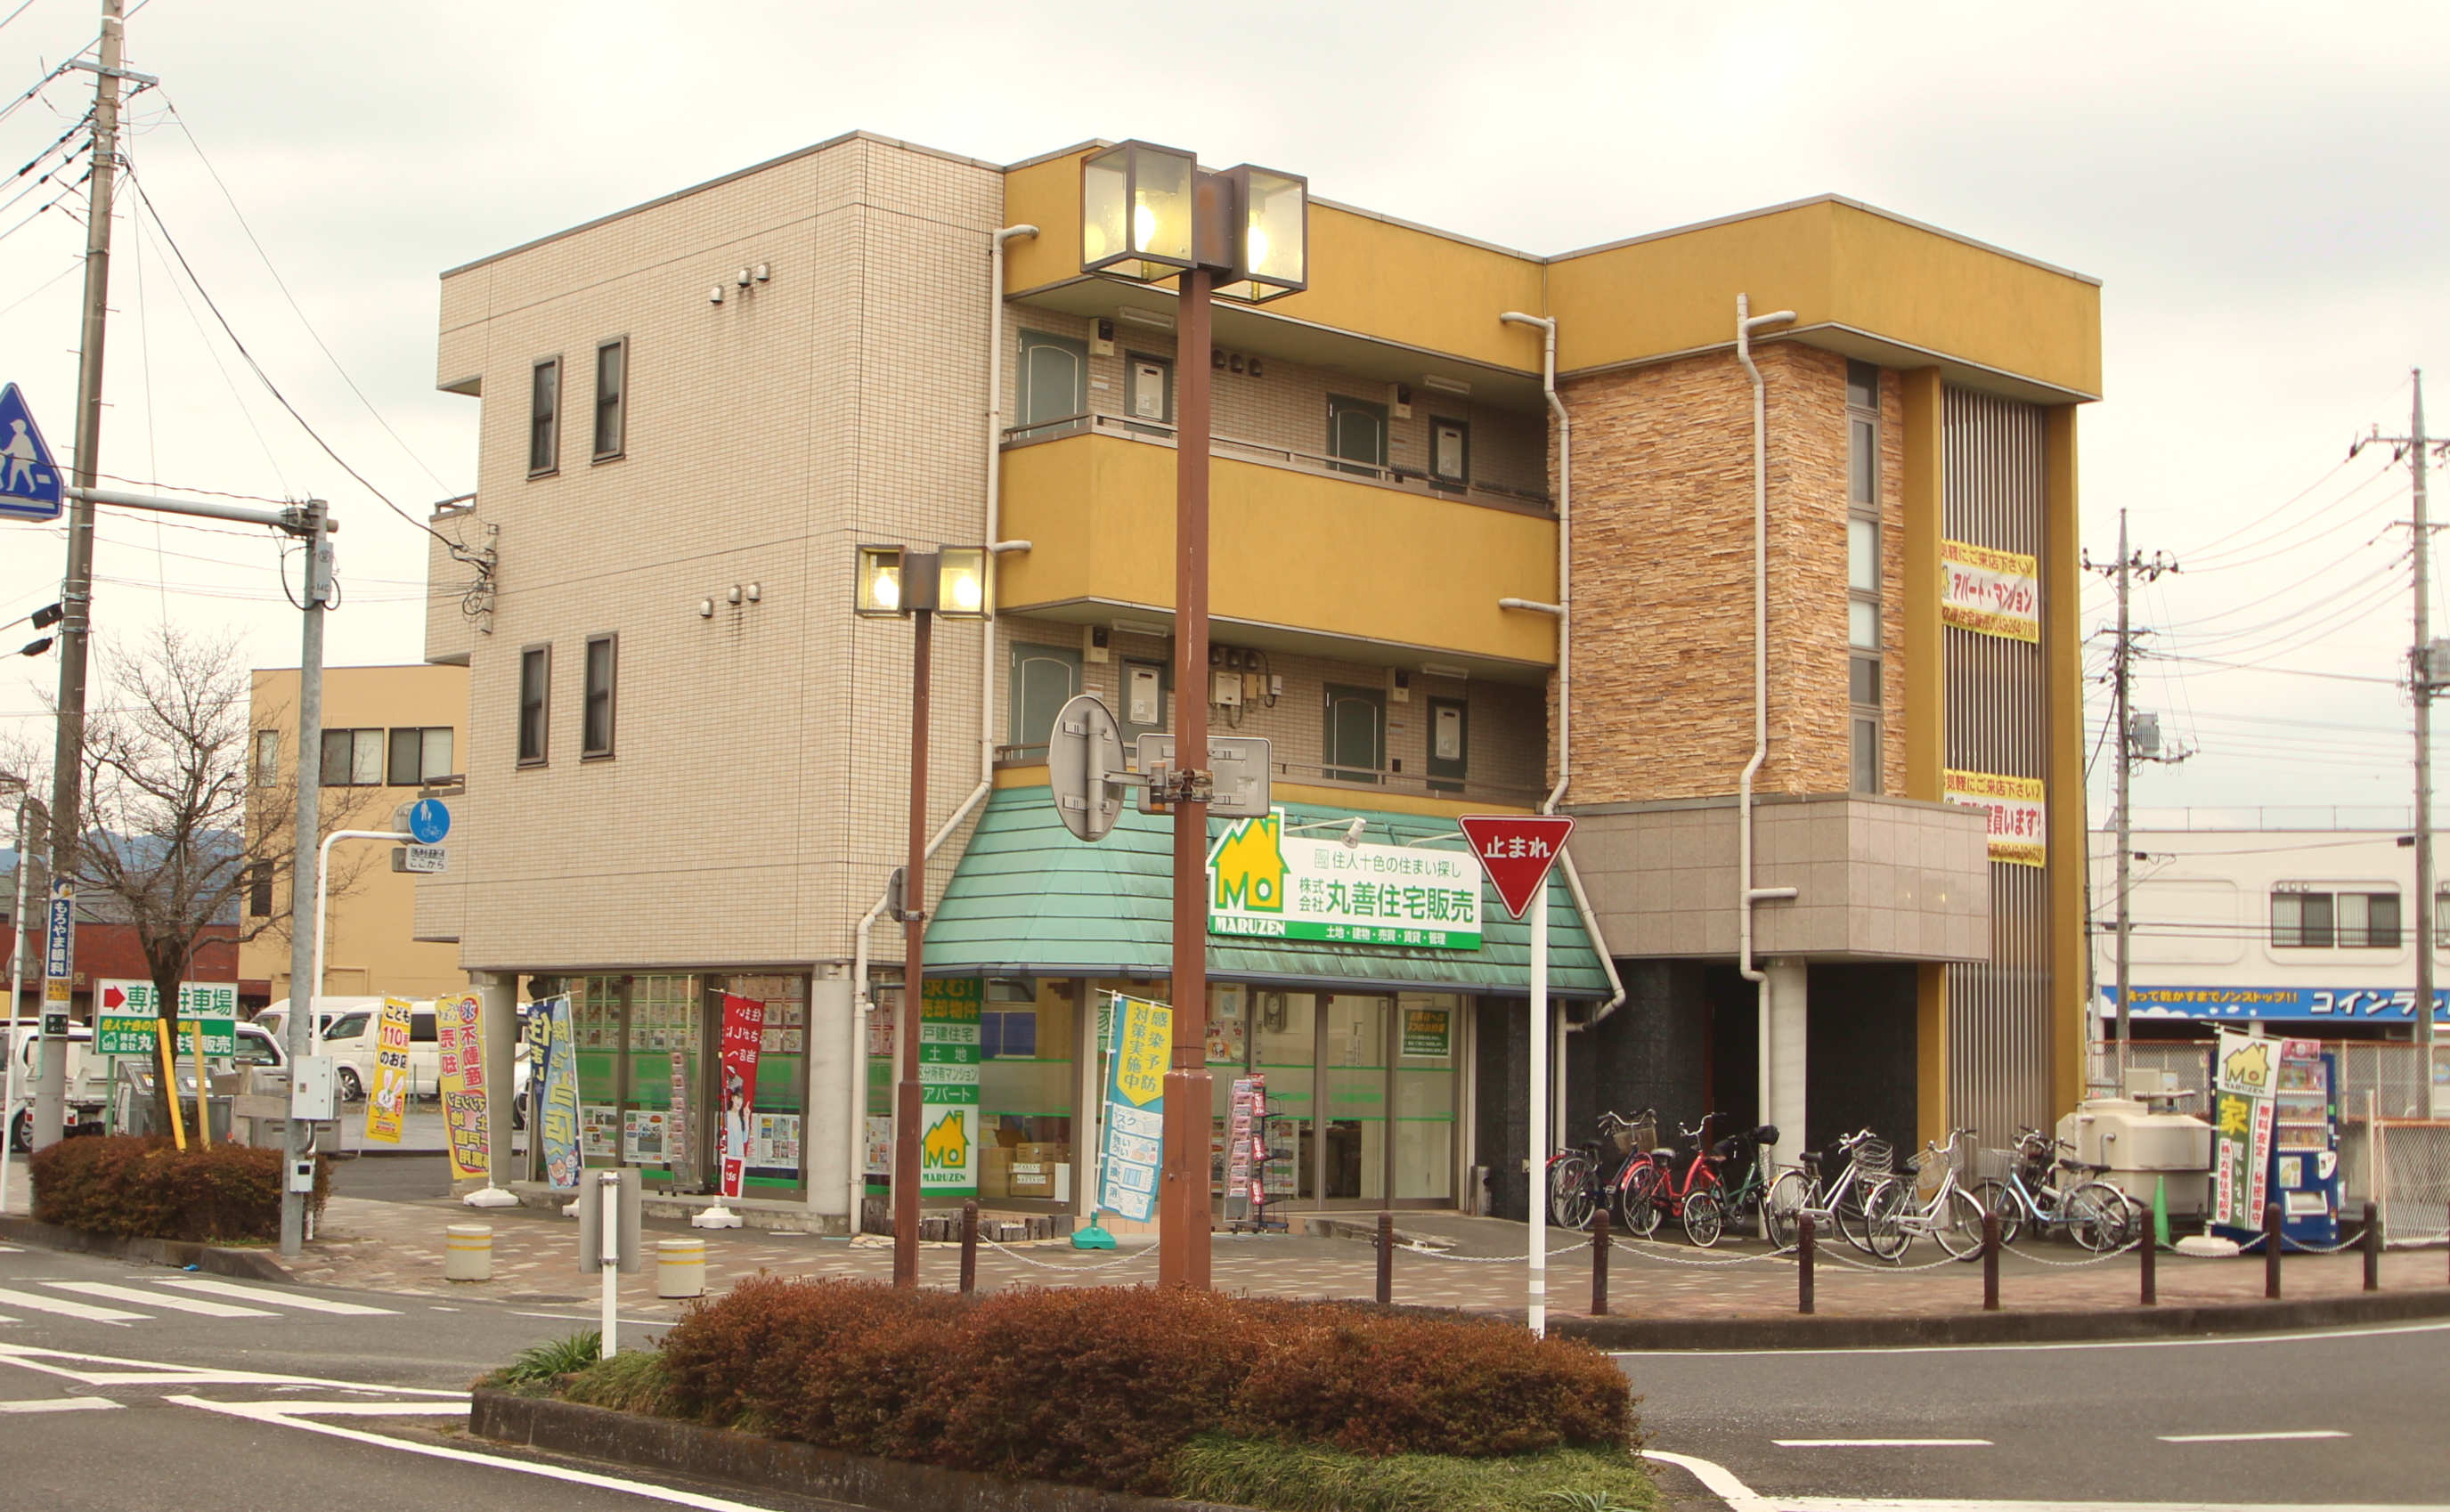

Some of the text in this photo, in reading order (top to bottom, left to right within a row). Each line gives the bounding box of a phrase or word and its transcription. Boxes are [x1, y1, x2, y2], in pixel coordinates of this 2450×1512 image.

[1484, 835, 1551, 858] 止まれ
[410, 858, 445, 870] ここから
[1332, 850, 1461, 878] 住人十色の住まい探し
[1298, 876, 1325, 895] 株式
[1298, 896, 1325, 914] 会社
[1326, 879, 1475, 923] 丸善住宅販売
[1215, 916, 1286, 936] MARUZEN
[50, 901, 69, 976] もろやま眼科
[2310, 990, 2450, 1016] コインラ
[385, 1004, 411, 1024] こども
[138, 1033, 232, 1053] 丸住宅販売
[923, 1025, 975, 1043] 戸建住宅
[1124, 1005, 1150, 1089] 対策実施中
[1140, 1011, 1168, 1093] 感染予防
[924, 1086, 971, 1102] アパート
[2219, 1094, 2249, 1136] 家
[923, 1173, 967, 1183] MARUZEN
